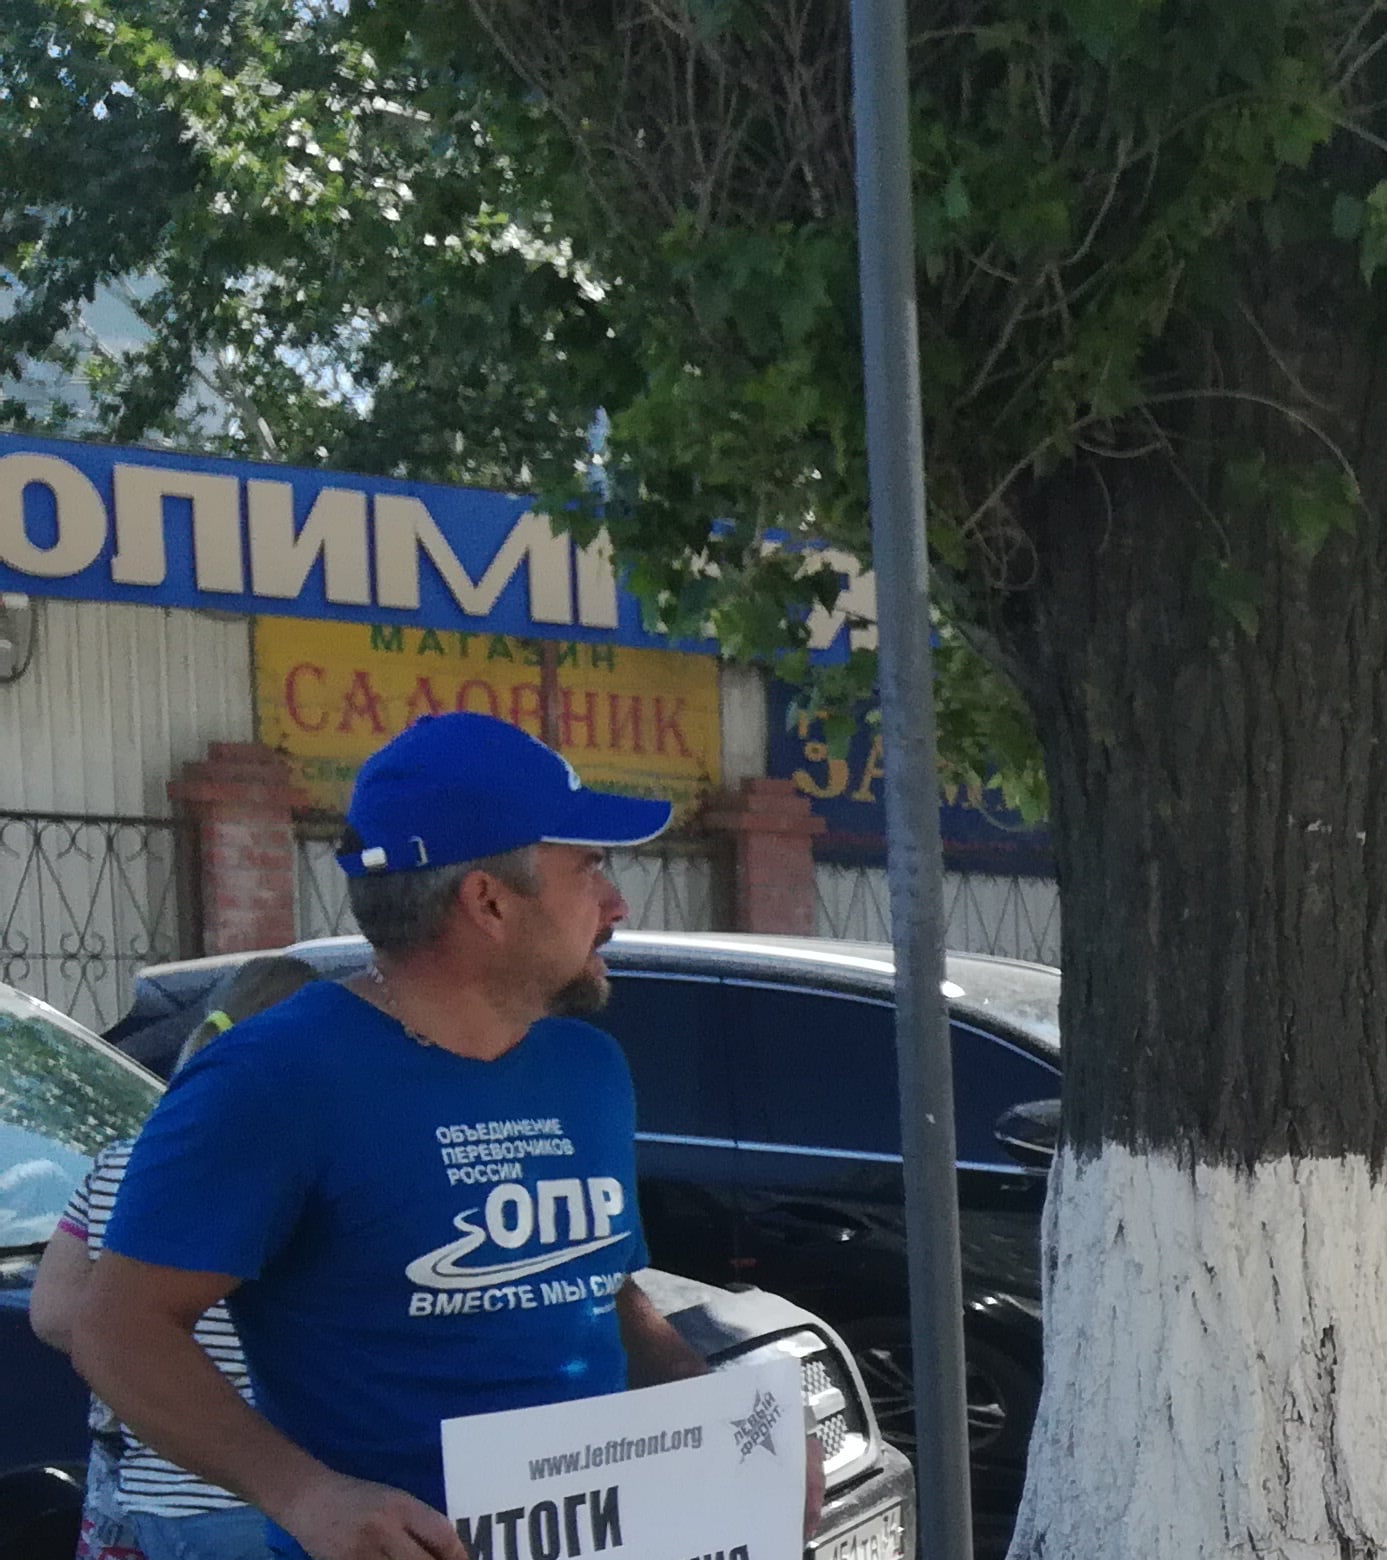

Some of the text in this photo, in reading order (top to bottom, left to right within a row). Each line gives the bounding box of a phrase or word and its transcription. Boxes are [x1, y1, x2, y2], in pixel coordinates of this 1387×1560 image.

[435, 1118, 563, 1145] ОБЪЕДИНЕНИЕ
[441, 1138, 575, 1165] ПЕРЕВОЗЧИКОВ
[447, 1162, 523, 1186] РОССИИ
[485, 1177, 624, 1249] ОПР
[408, 1285, 538, 1317] ВМЕСТЕ
[541, 1277, 586, 1306] МЫ
[528, 1425, 703, 1481] www.leftfront.org
